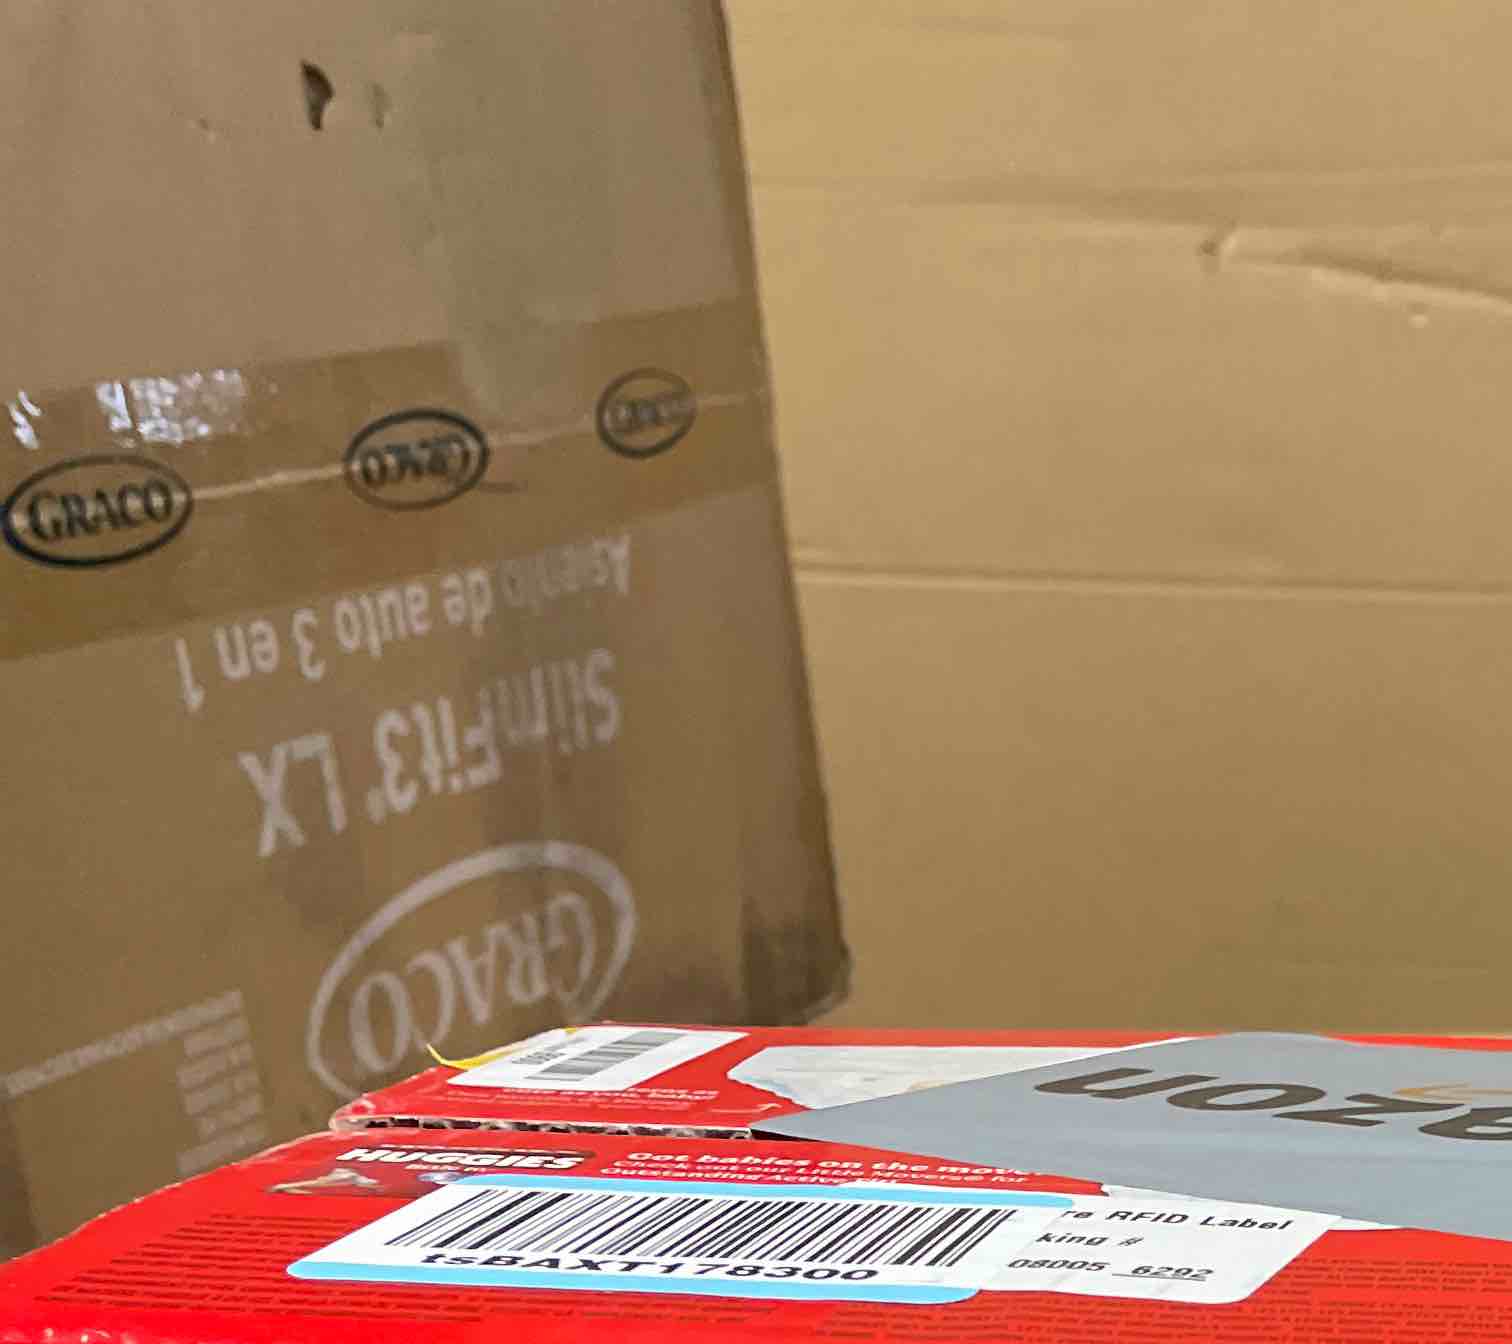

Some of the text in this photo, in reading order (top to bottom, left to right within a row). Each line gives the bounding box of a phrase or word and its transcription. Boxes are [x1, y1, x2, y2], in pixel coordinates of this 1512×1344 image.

[28, 477, 173, 541] GRACO
[335, 582, 430, 658] auto
[441, 568, 493, 637] de
[175, 638, 204, 713] 1
[215, 619, 279, 680] en
[293, 608, 326, 681] 3
[237, 733, 348, 857] LX
[349, 894, 595, 1073] GRACO
[336, 1148, 585, 1169] HUGGIES
[600, 1167, 761, 1181] Outstanding
[613, 1160, 689, 1170] Check
[628, 1152, 688, 1162] Got
[697, 1154, 811, 1167] babies
[818, 1160, 862, 1169] on
[872, 1161, 929, 1172] the
[1106, 1210, 1190, 1224] RFID
[1200, 1215, 1294, 1231] Label
[420, 1252, 880, 1282] tsBAXT178300
